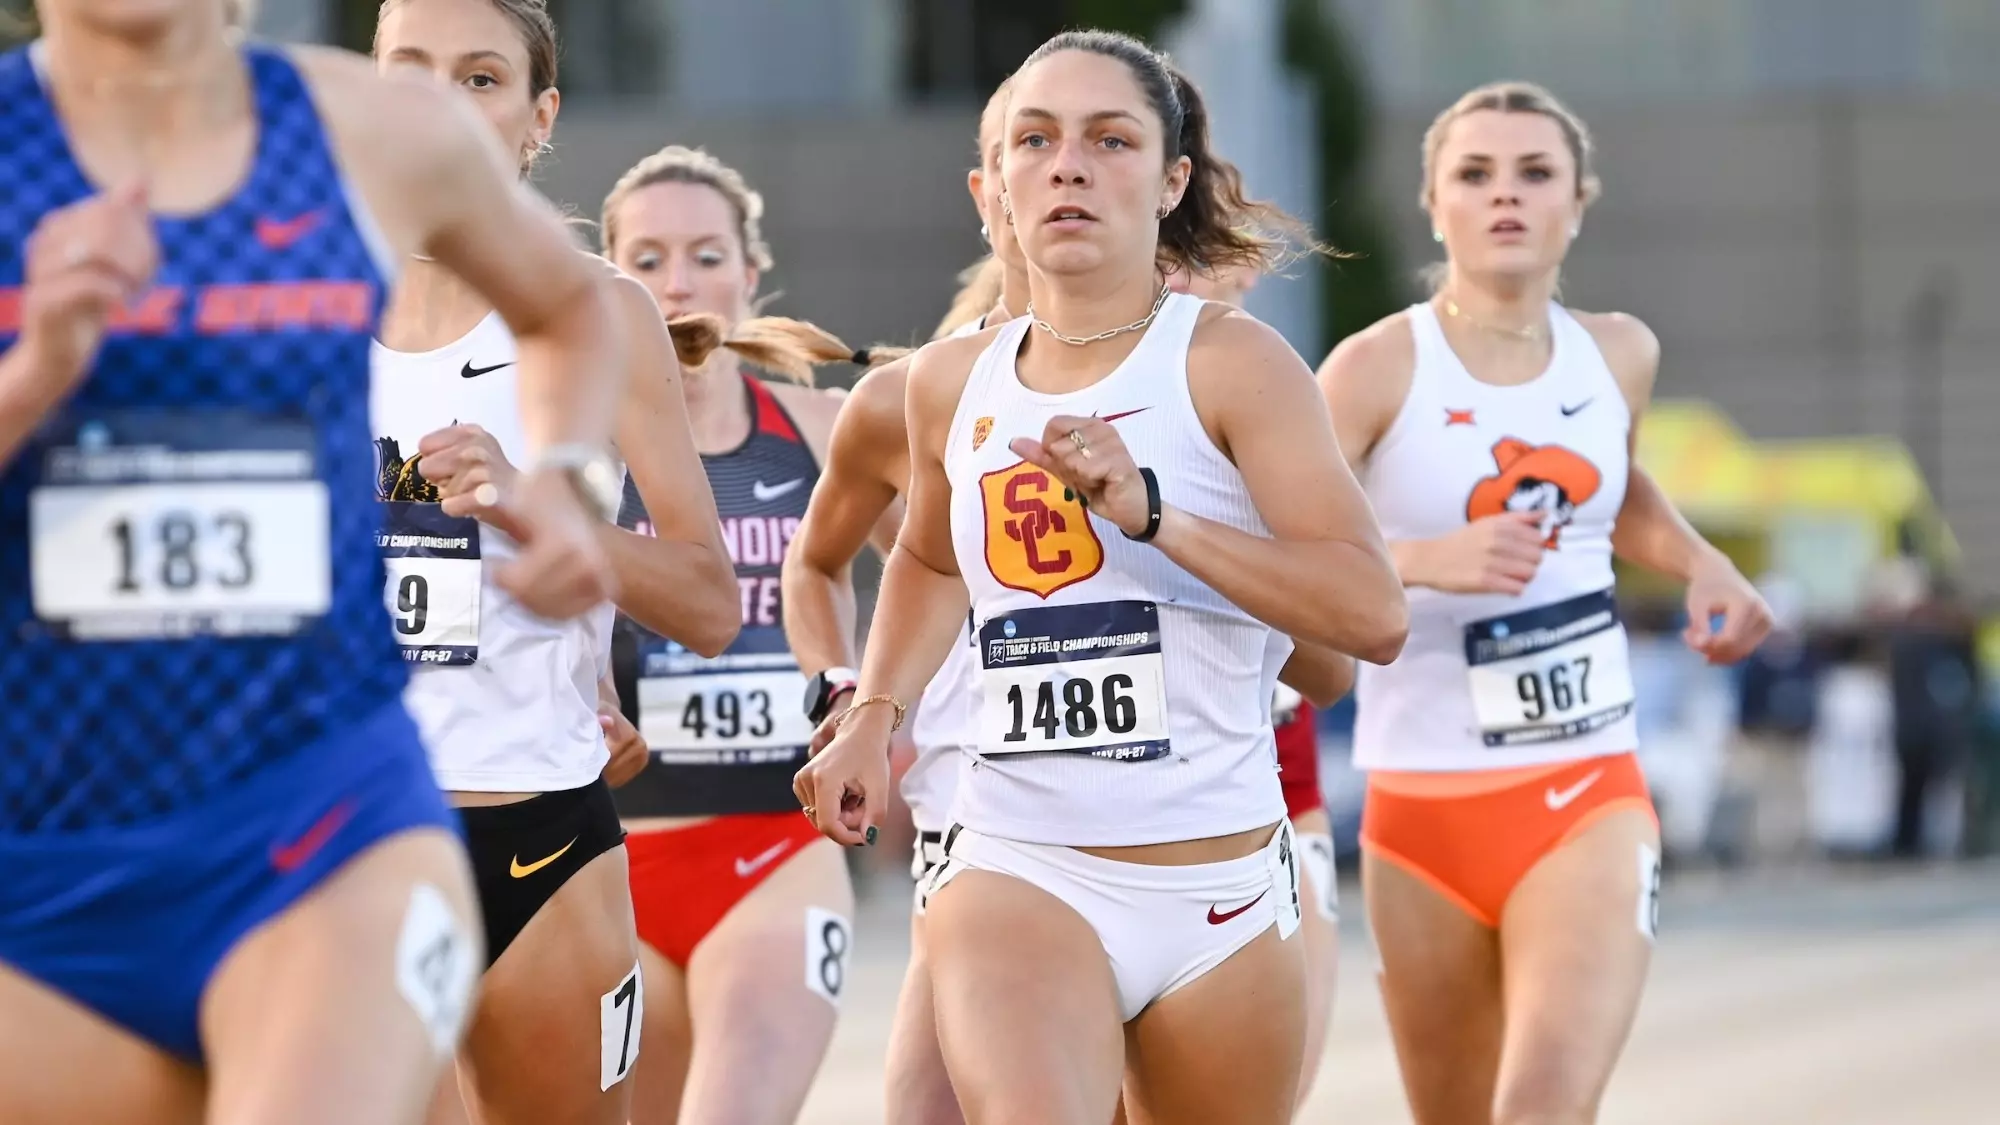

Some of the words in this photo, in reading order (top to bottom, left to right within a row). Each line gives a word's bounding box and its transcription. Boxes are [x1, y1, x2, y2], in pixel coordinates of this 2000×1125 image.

[110, 515, 254, 594] 183
[390, 534, 469, 550] CHAMPIONSHIPS
[1004, 471, 1072, 574] SC
[385, 574, 428, 634] 9
[420, 649, 453, 662] 24-27
[1005, 643, 1030, 656] TRACK
[1030, 642, 1037, 655] &
[1037, 640, 1060, 654] FIELD
[1062, 631, 1149, 652] CHAMPIONSHIPS
[681, 690, 774, 739] 493
[1003, 673, 1137, 742] 1486
[1516, 653, 1592, 722] 967
[1115, 745, 1146, 760] 24-27
[821, 918, 847, 997] 8
[614, 973, 636, 1077] 7
